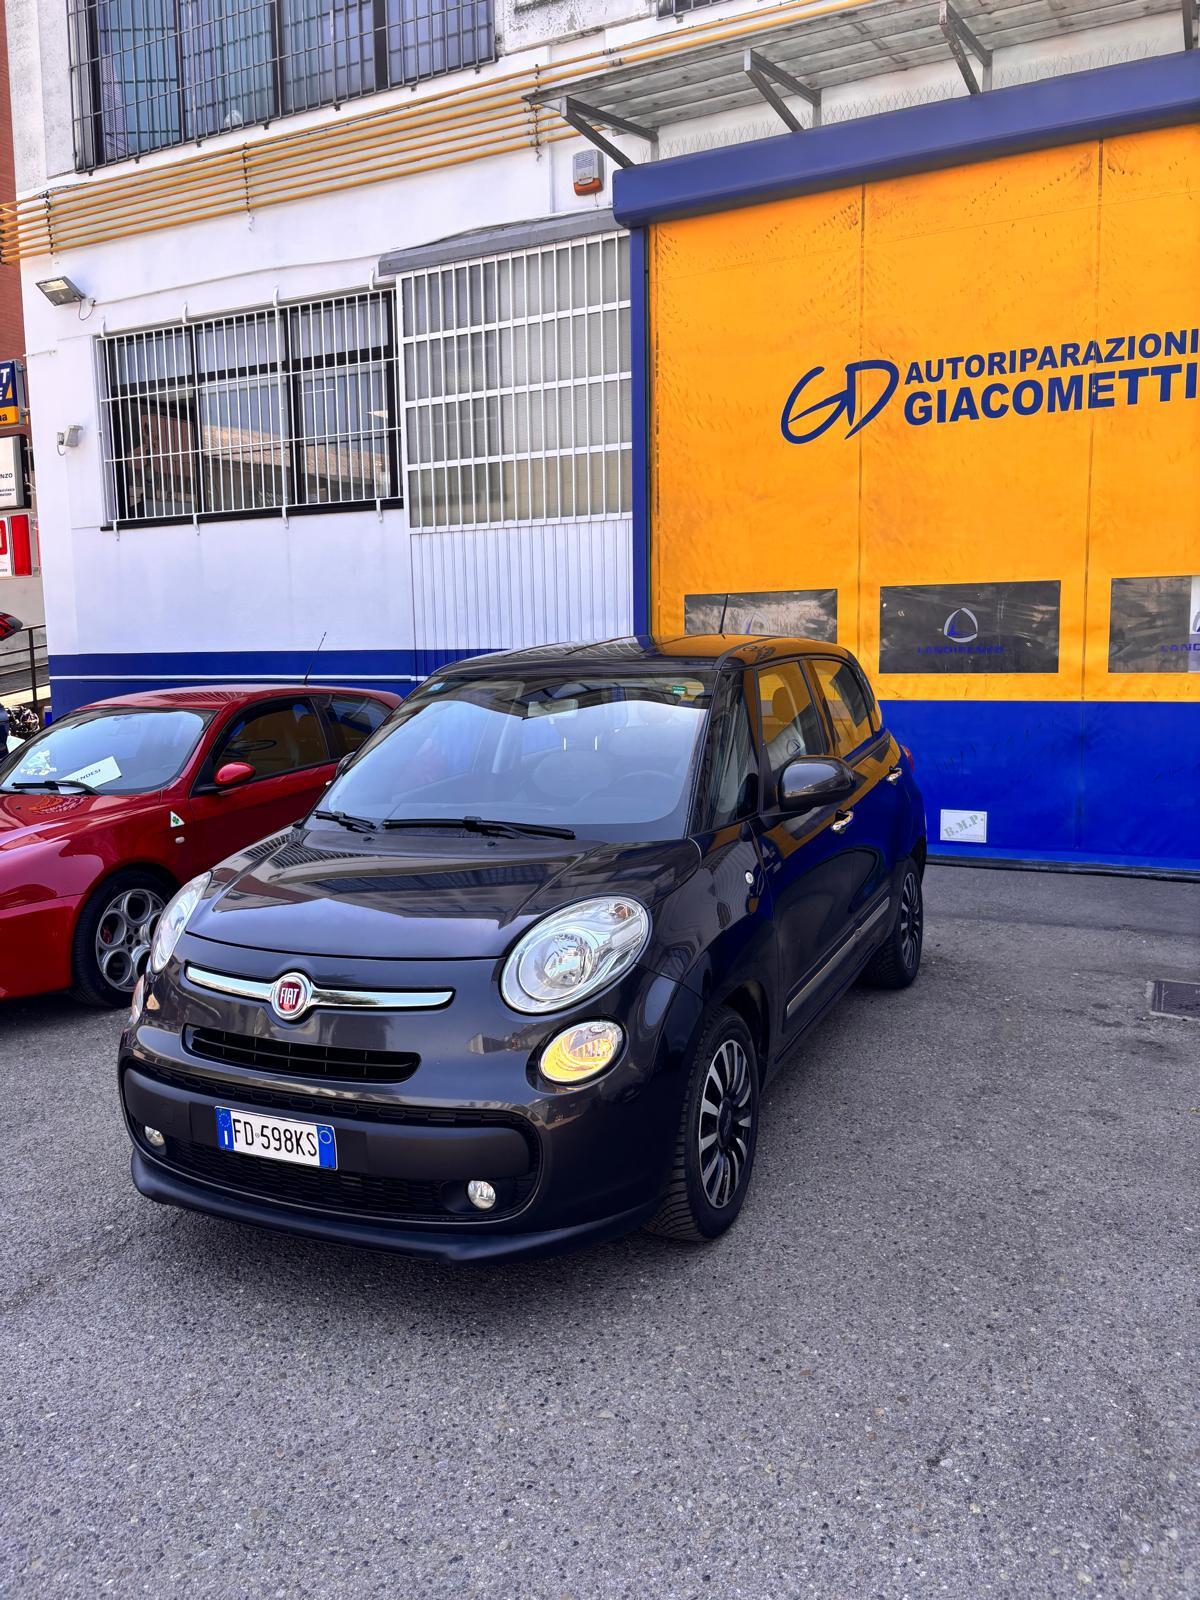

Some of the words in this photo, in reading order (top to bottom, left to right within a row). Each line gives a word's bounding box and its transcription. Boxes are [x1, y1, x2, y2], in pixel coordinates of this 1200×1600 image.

[904, 329, 1198, 385] AUTORIPARAZIONI
[904, 362, 1197, 426] GIACOMETTI
[279, 986, 299, 1006] FIAT
